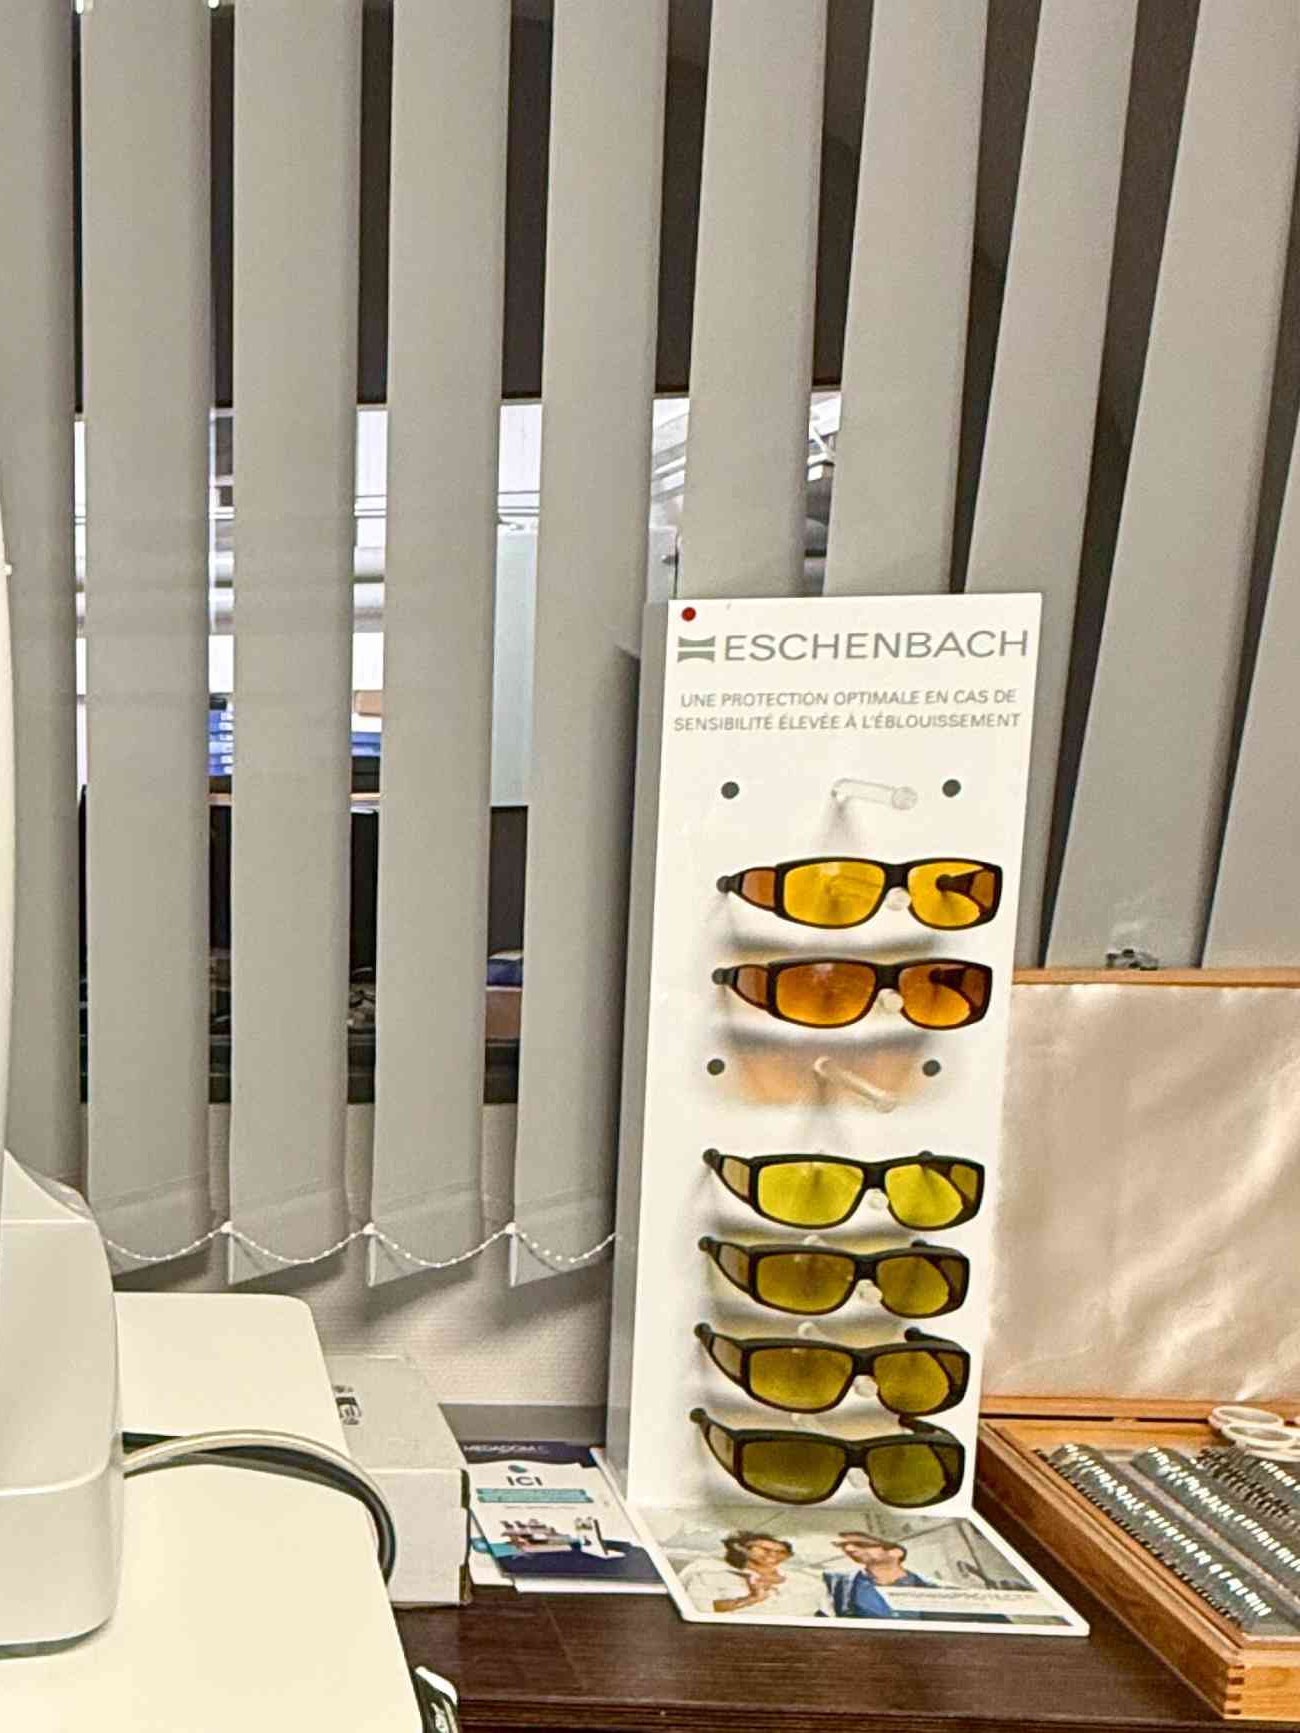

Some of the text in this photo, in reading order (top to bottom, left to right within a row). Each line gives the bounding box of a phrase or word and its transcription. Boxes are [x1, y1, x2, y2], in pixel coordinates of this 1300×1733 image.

[724, 629, 1029, 662] ESCHENBACH
[680, 689, 1017, 708] UNE PROTECTION OPTIMALE EN CAS DE
[674, 710, 1021, 731] SENSIBILITÉ ÉLEVÉE À L'ÉBLOUISSEMENT
[506, 1475, 544, 1487] ICI
